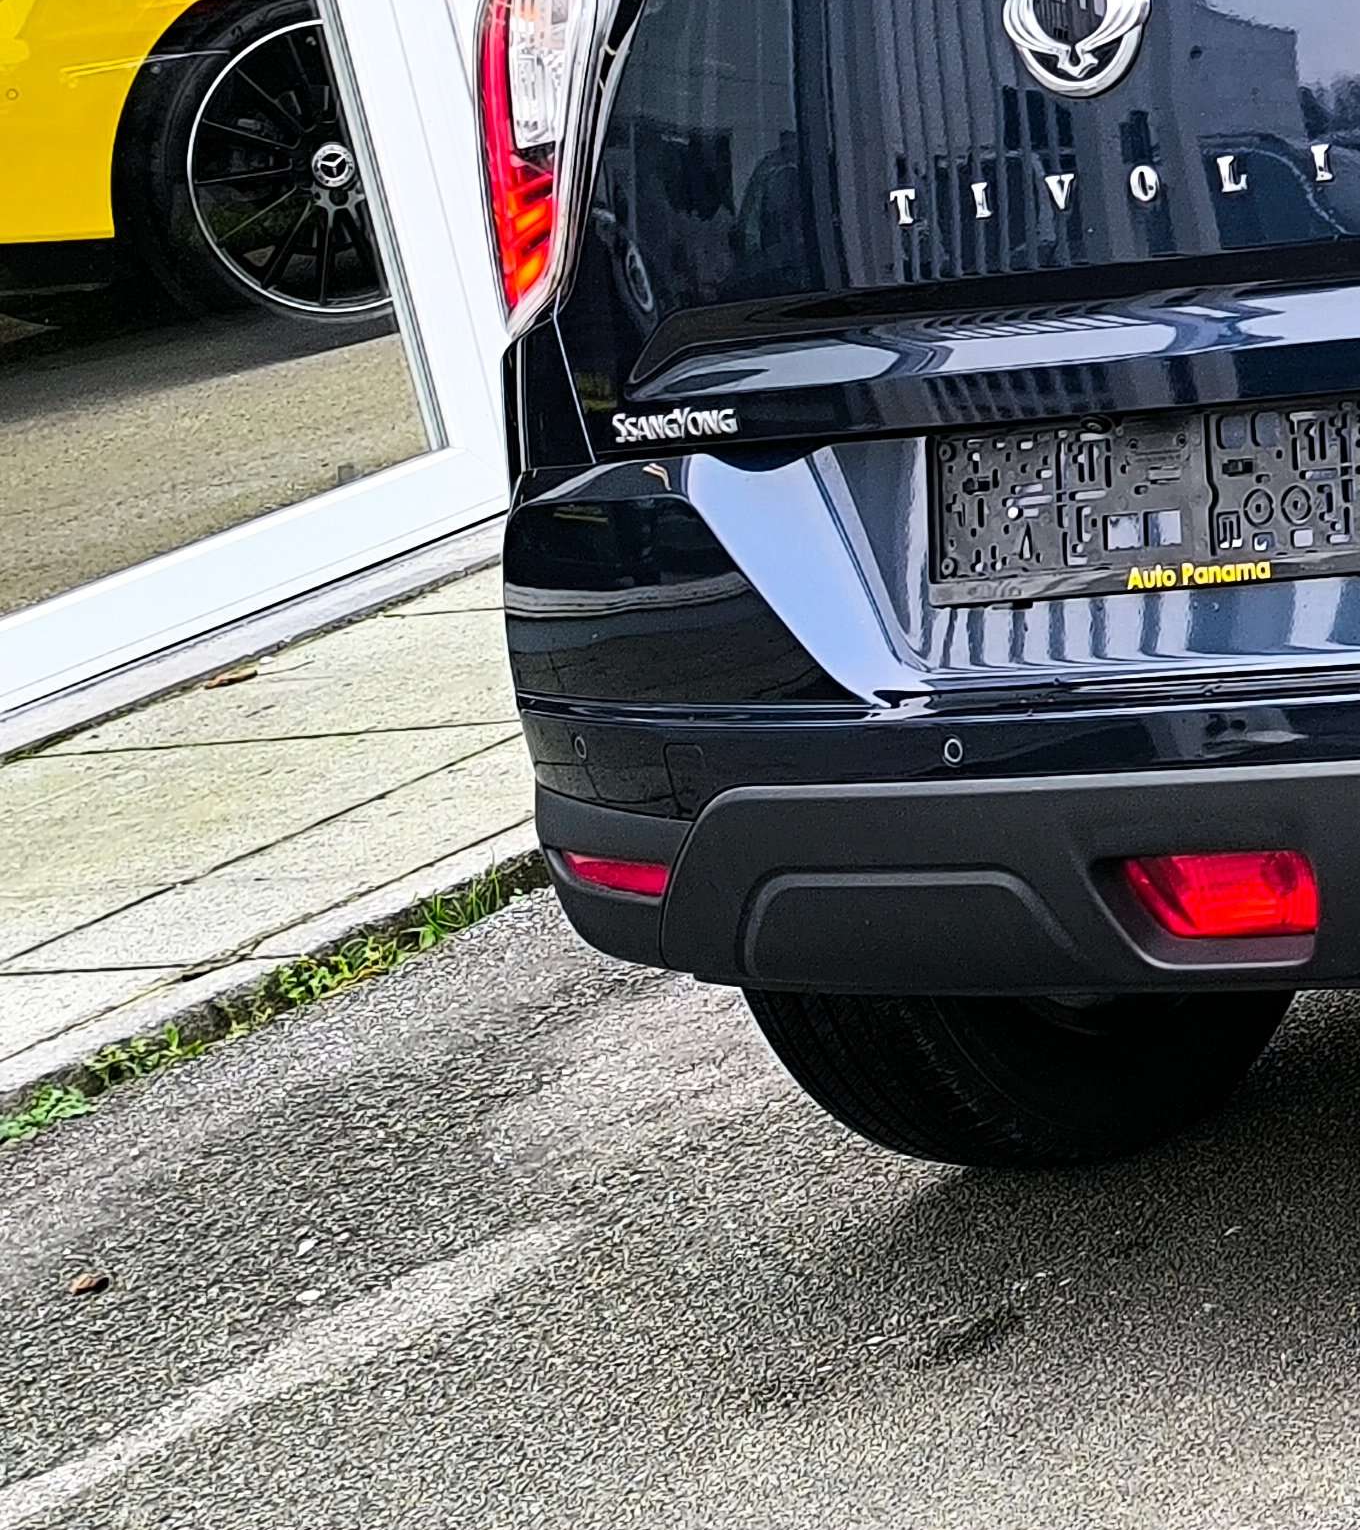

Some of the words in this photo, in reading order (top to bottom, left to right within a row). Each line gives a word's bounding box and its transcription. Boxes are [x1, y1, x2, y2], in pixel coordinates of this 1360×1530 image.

[889, 143, 1334, 226] TIVOLI
[1126, 562, 1178, 591] Auto
[1181, 558, 1272, 586] Panama
